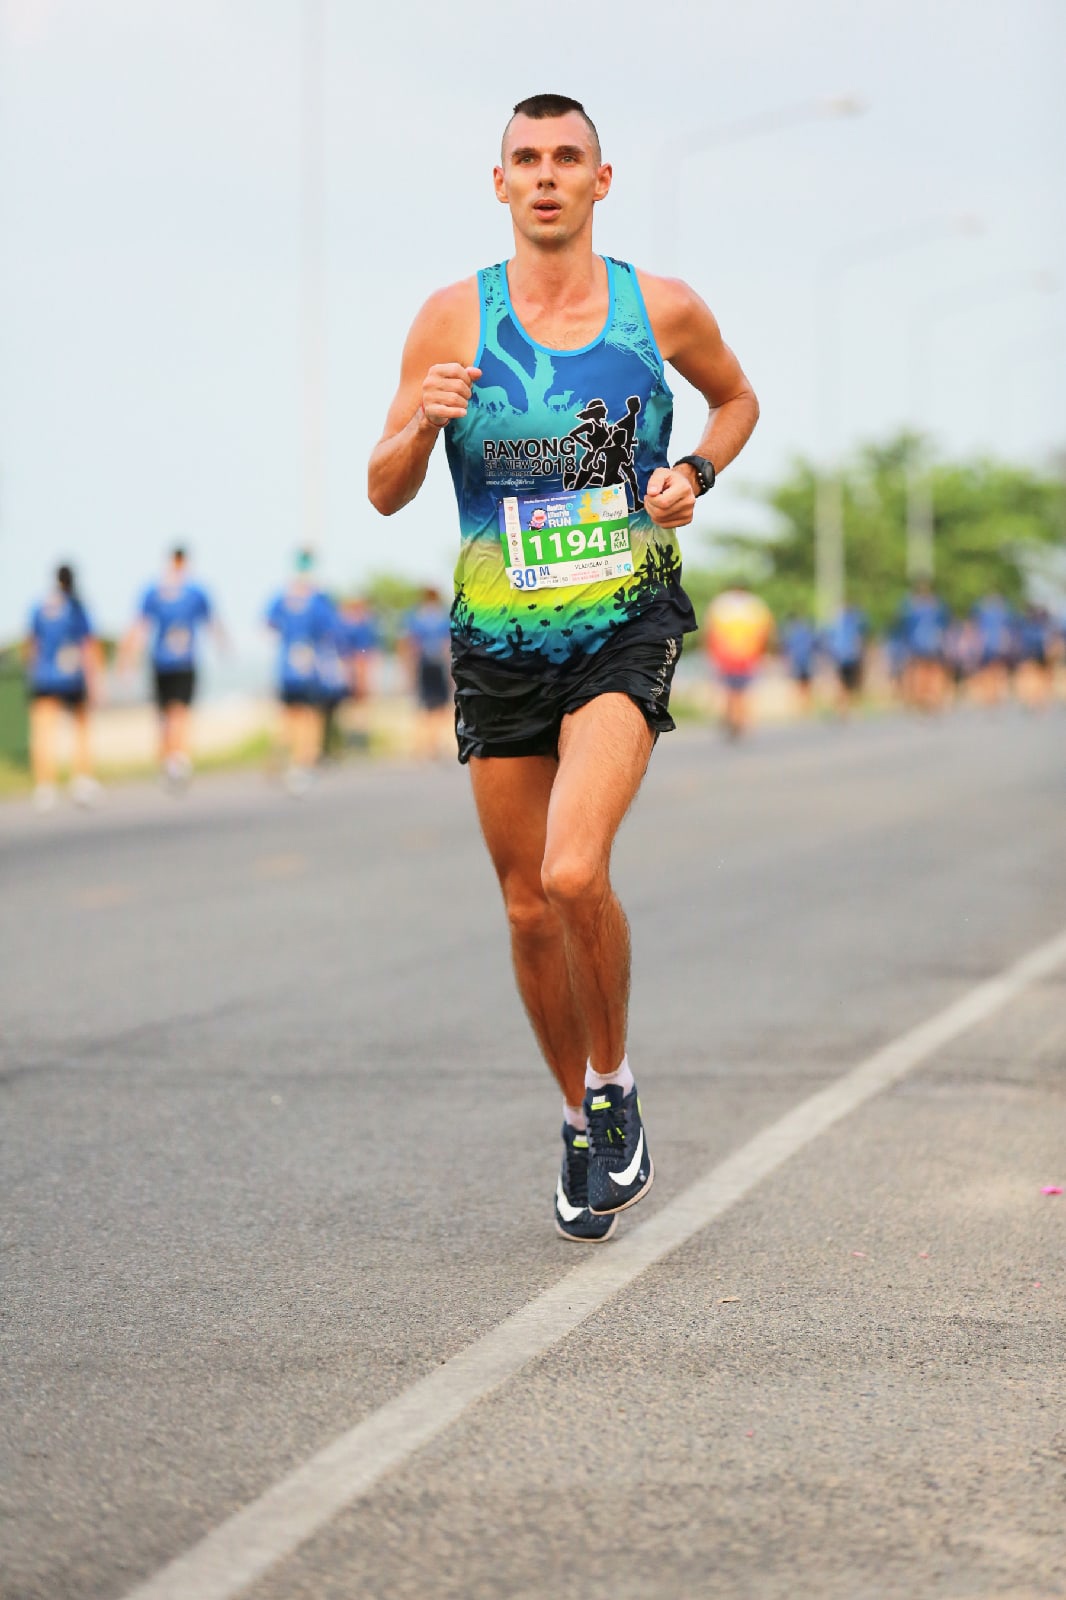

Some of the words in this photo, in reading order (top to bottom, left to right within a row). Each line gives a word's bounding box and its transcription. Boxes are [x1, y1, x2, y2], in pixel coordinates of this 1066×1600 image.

[483, 437, 576, 459] RAYONG
[485, 460, 503, 470] SEA
[505, 459, 530, 470] VIEW
[531, 457, 576, 476] 2018
[548, 517, 572, 528] RUN
[529, 526, 607, 560] 1194
[614, 530, 625, 541] 21
[613, 540, 627, 549] KM
[512, 568, 537, 589] 30
[539, 566, 550, 576] M
